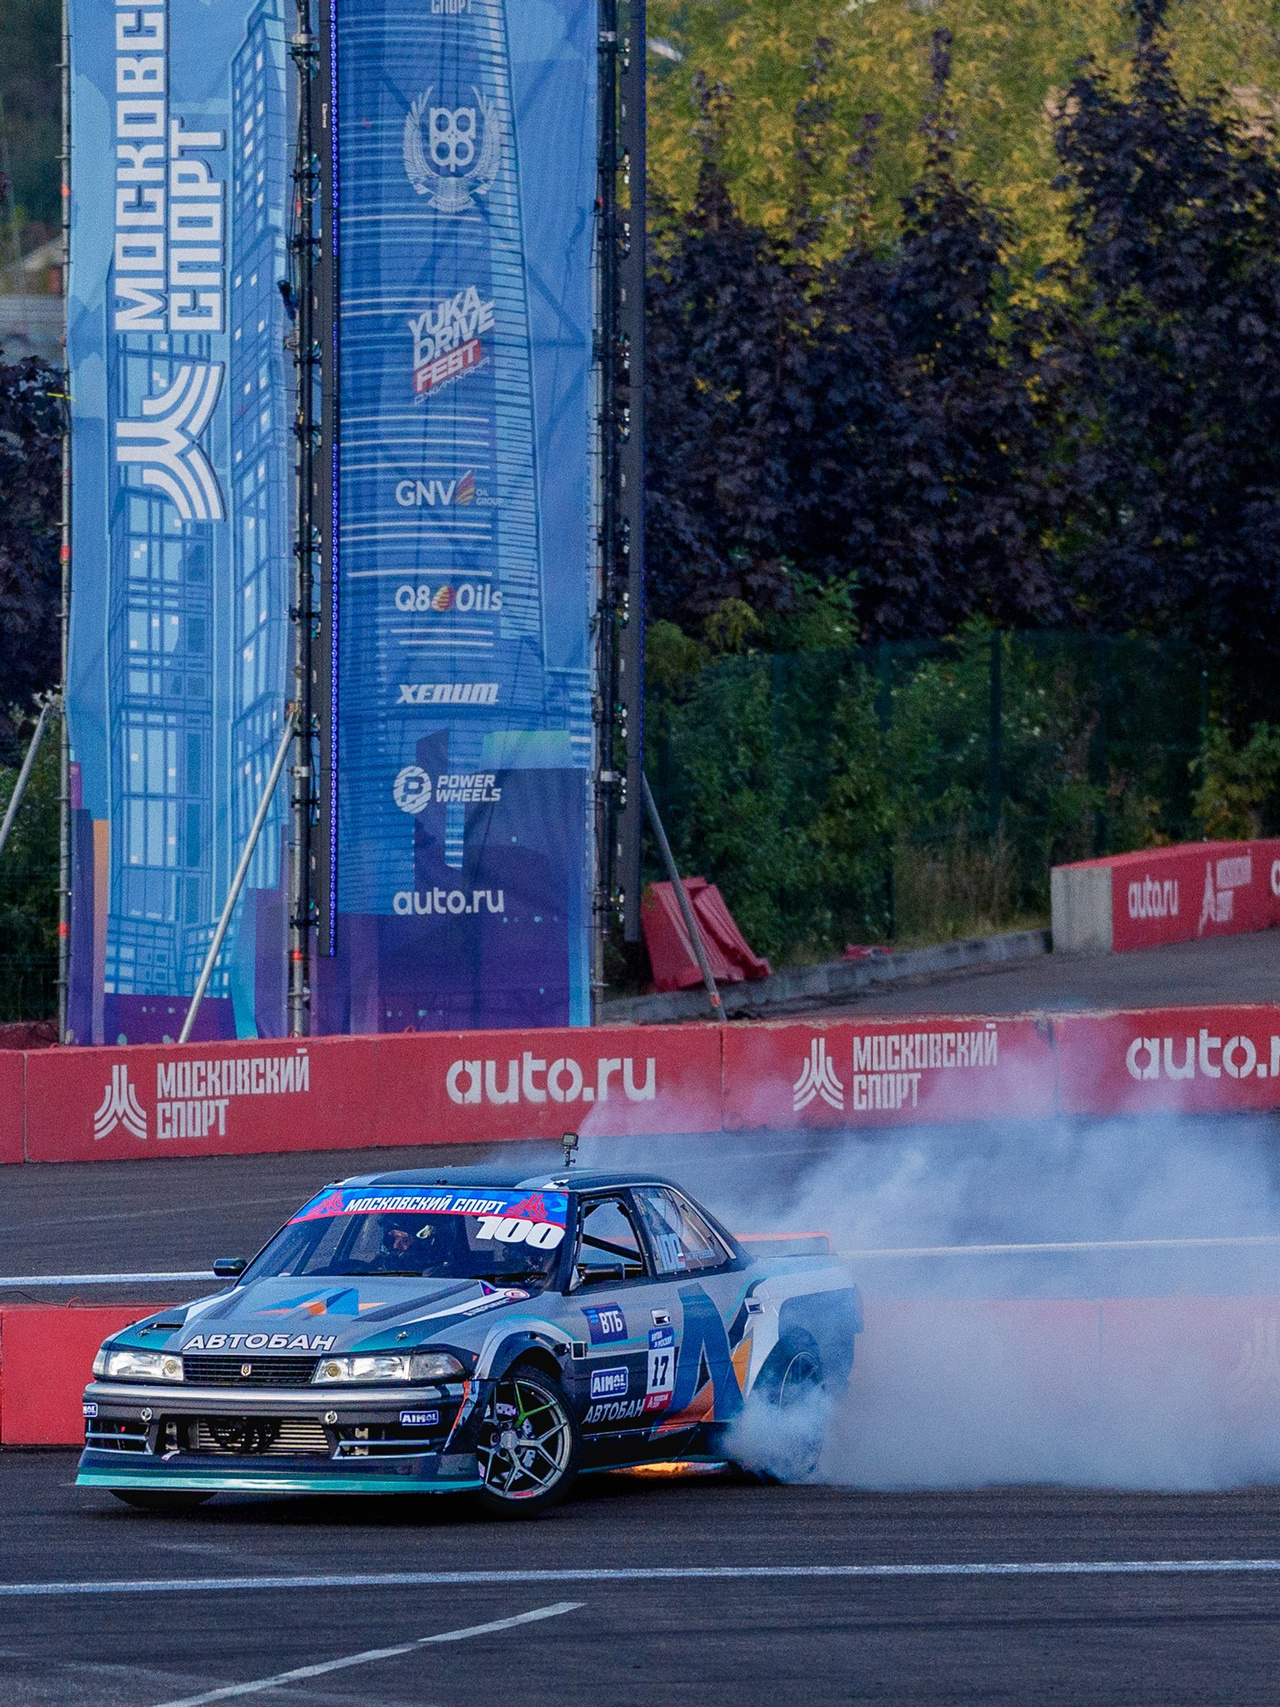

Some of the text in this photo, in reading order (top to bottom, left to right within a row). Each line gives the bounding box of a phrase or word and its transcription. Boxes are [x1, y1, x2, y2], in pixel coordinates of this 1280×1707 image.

[115, 0, 165, 331] МОСКОВС
[170, 119, 226, 331] СПОРТ
[408, 285, 482, 342] YUKA
[414, 300, 496, 371] DRIVE
[416, 338, 480, 392] FEST
[395, 479, 457, 506] GNV
[395, 585, 504, 613] Q8 Oils
[435, 788, 503, 802] WHEELS
[437, 774, 496, 789] POWER
[393, 888, 505, 915] auto.ru
[1127, 874, 1179, 919] auto.ru
[853, 1022, 999, 1072] МОСКОВСКИЙ
[157, 1048, 310, 1099] МОСКОВСКИЙ
[446, 1050, 657, 1105] auto.ru
[853, 1071, 922, 1111] СПОРТ
[157, 1098, 230, 1140] СПОРТ
[344, 1194, 508, 1214] МОСКОВСКИЙ СПОРТ
[475, 1215, 567, 1251] 100
[599, 1310, 624, 1334] ВТБ
[181, 1332, 337, 1352] АВТОБАН
[651, 1355, 671, 1387] 17
[581, 1398, 647, 1425] АВТОБАН
